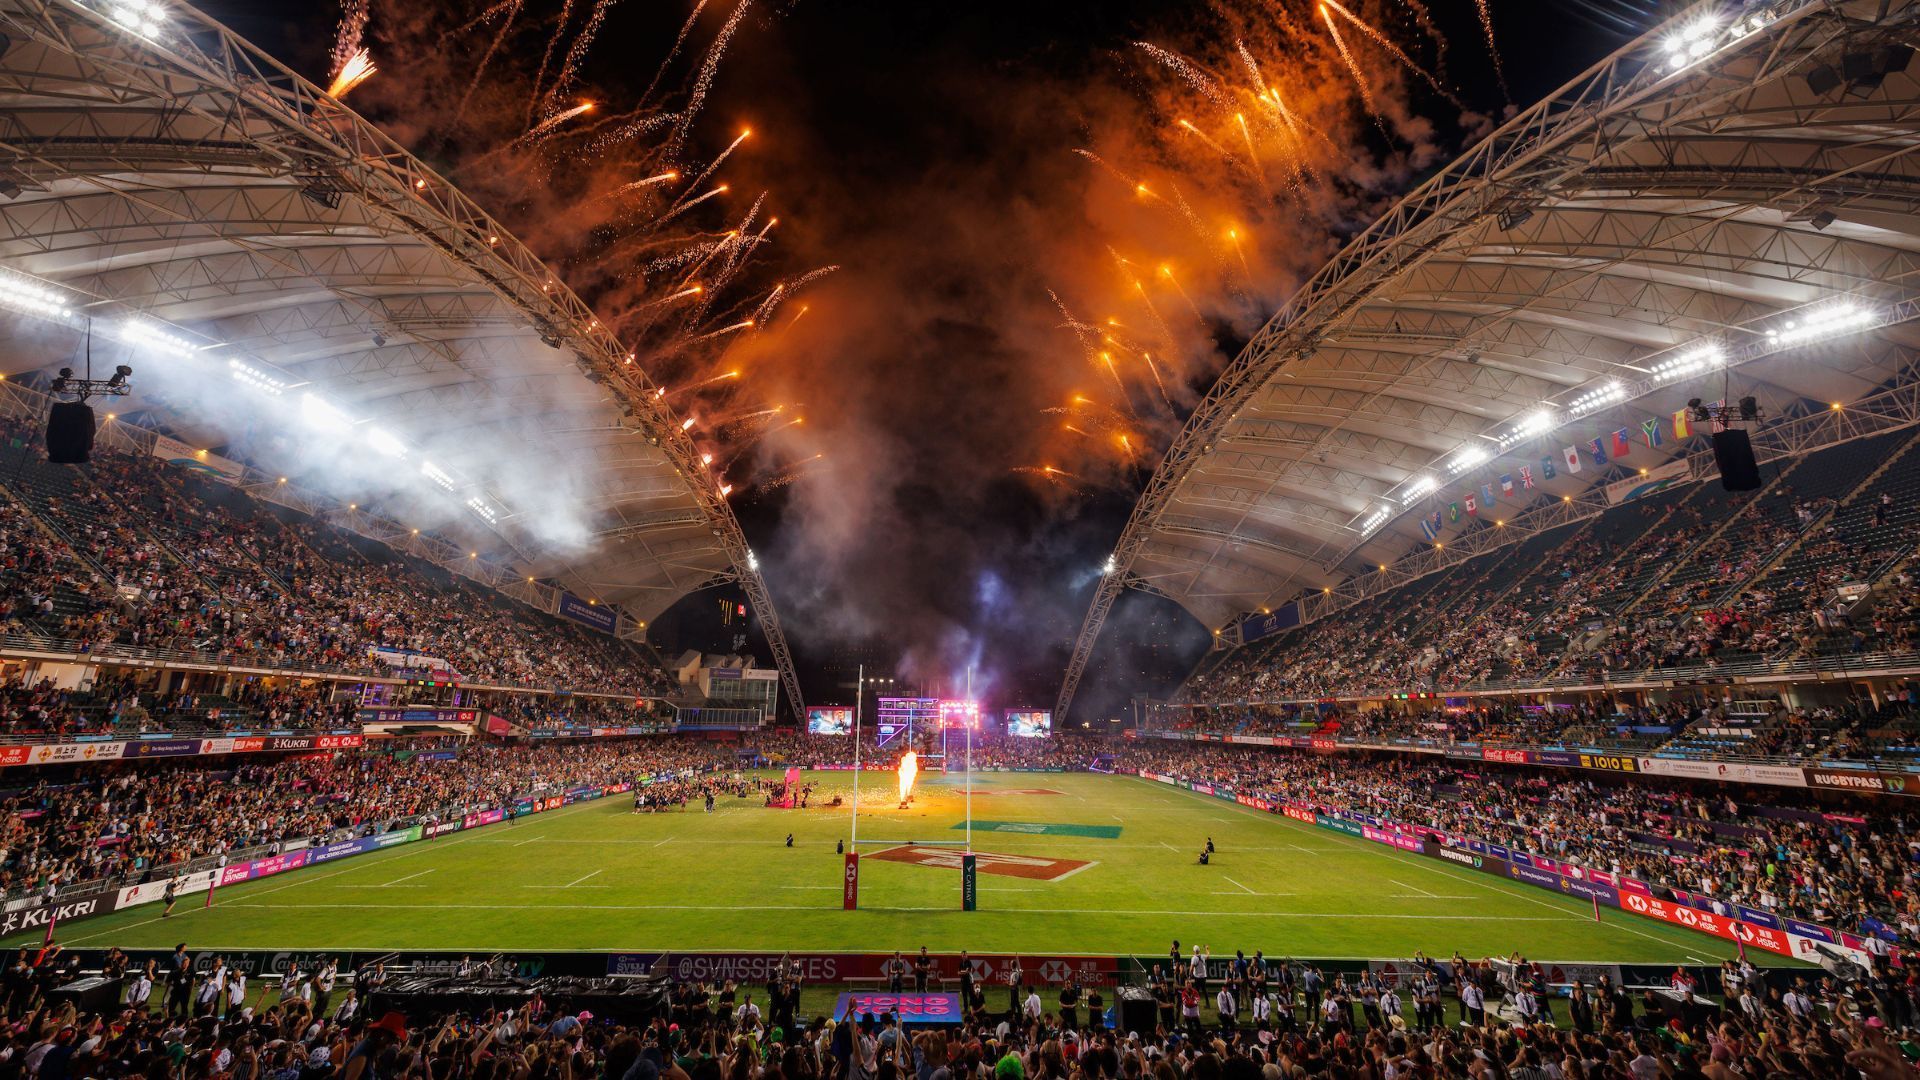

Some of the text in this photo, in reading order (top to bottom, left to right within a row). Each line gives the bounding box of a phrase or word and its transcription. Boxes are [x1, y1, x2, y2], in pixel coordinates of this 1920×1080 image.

[280, 738, 309, 748] KUKRI
[1814, 774, 1883, 789] RUGBYPASS
[1440, 849, 1473, 864] RUGBYPASS
[21, 899, 98, 929] KUKRI
[1650, 907, 1668, 918] HSBC
[1699, 920, 1719, 933] HSBC
[1756, 936, 1780, 950] HSBC
[1074, 972, 1103, 983] HSBC
[1649, 976, 1673, 985] CAT
[856, 997, 949, 1006] HONG
